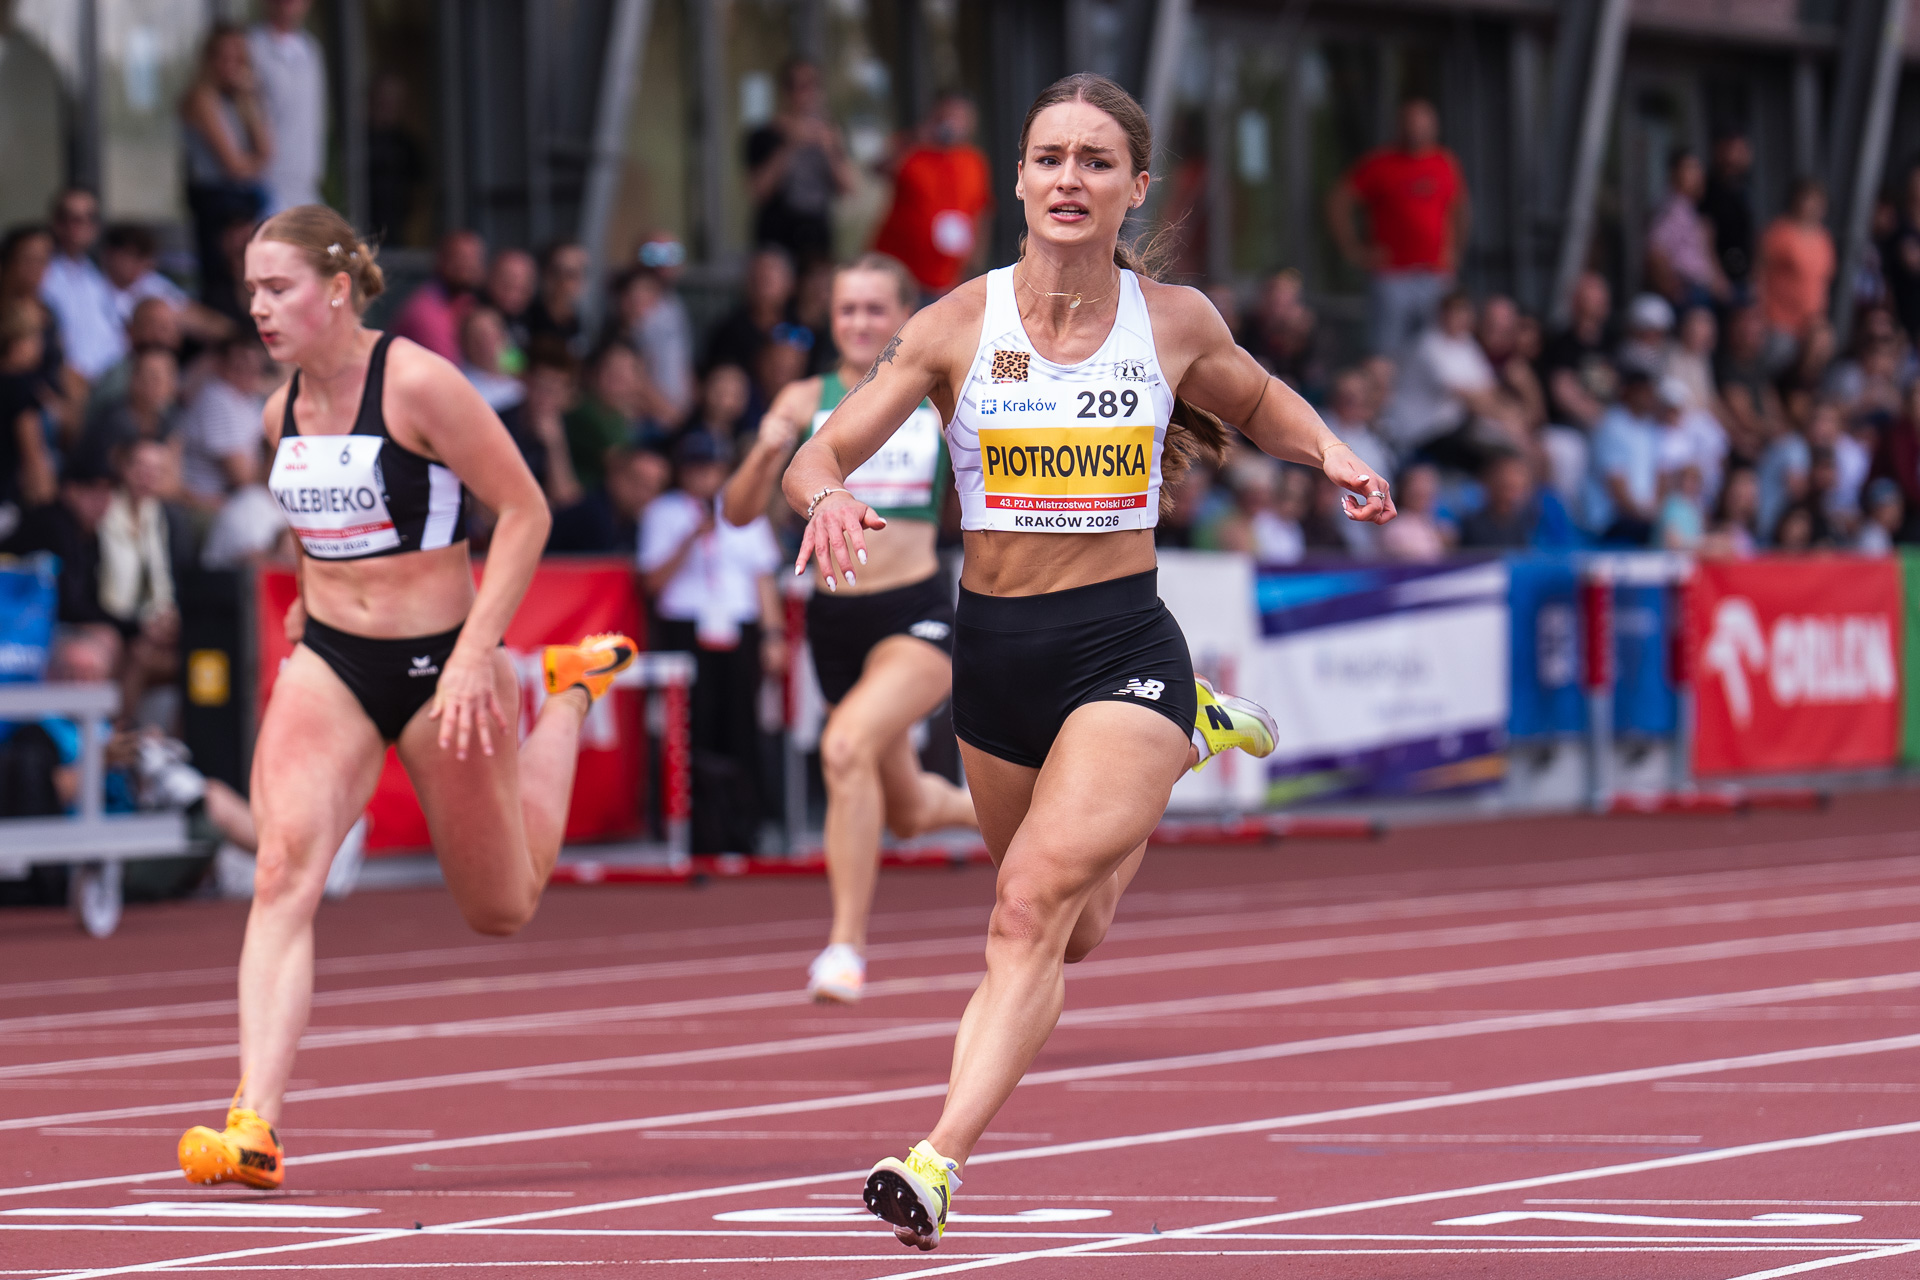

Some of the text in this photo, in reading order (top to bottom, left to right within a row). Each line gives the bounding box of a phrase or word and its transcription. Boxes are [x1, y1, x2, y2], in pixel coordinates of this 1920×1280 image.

[1003, 398, 1057, 412] Kraków
[1076, 389, 1139, 418] 289
[340, 443, 351, 465] 6
[986, 444, 1146, 478] PIOTROWSKA
[275, 486, 376, 513] KLEBIEKO
[1000, 498, 1136, 509] 43. PZLA Mistrzostwa Polski U23
[1015, 513, 1120, 528] KRAKÓW 2026
[1771, 614, 1895, 706] ORLEN
